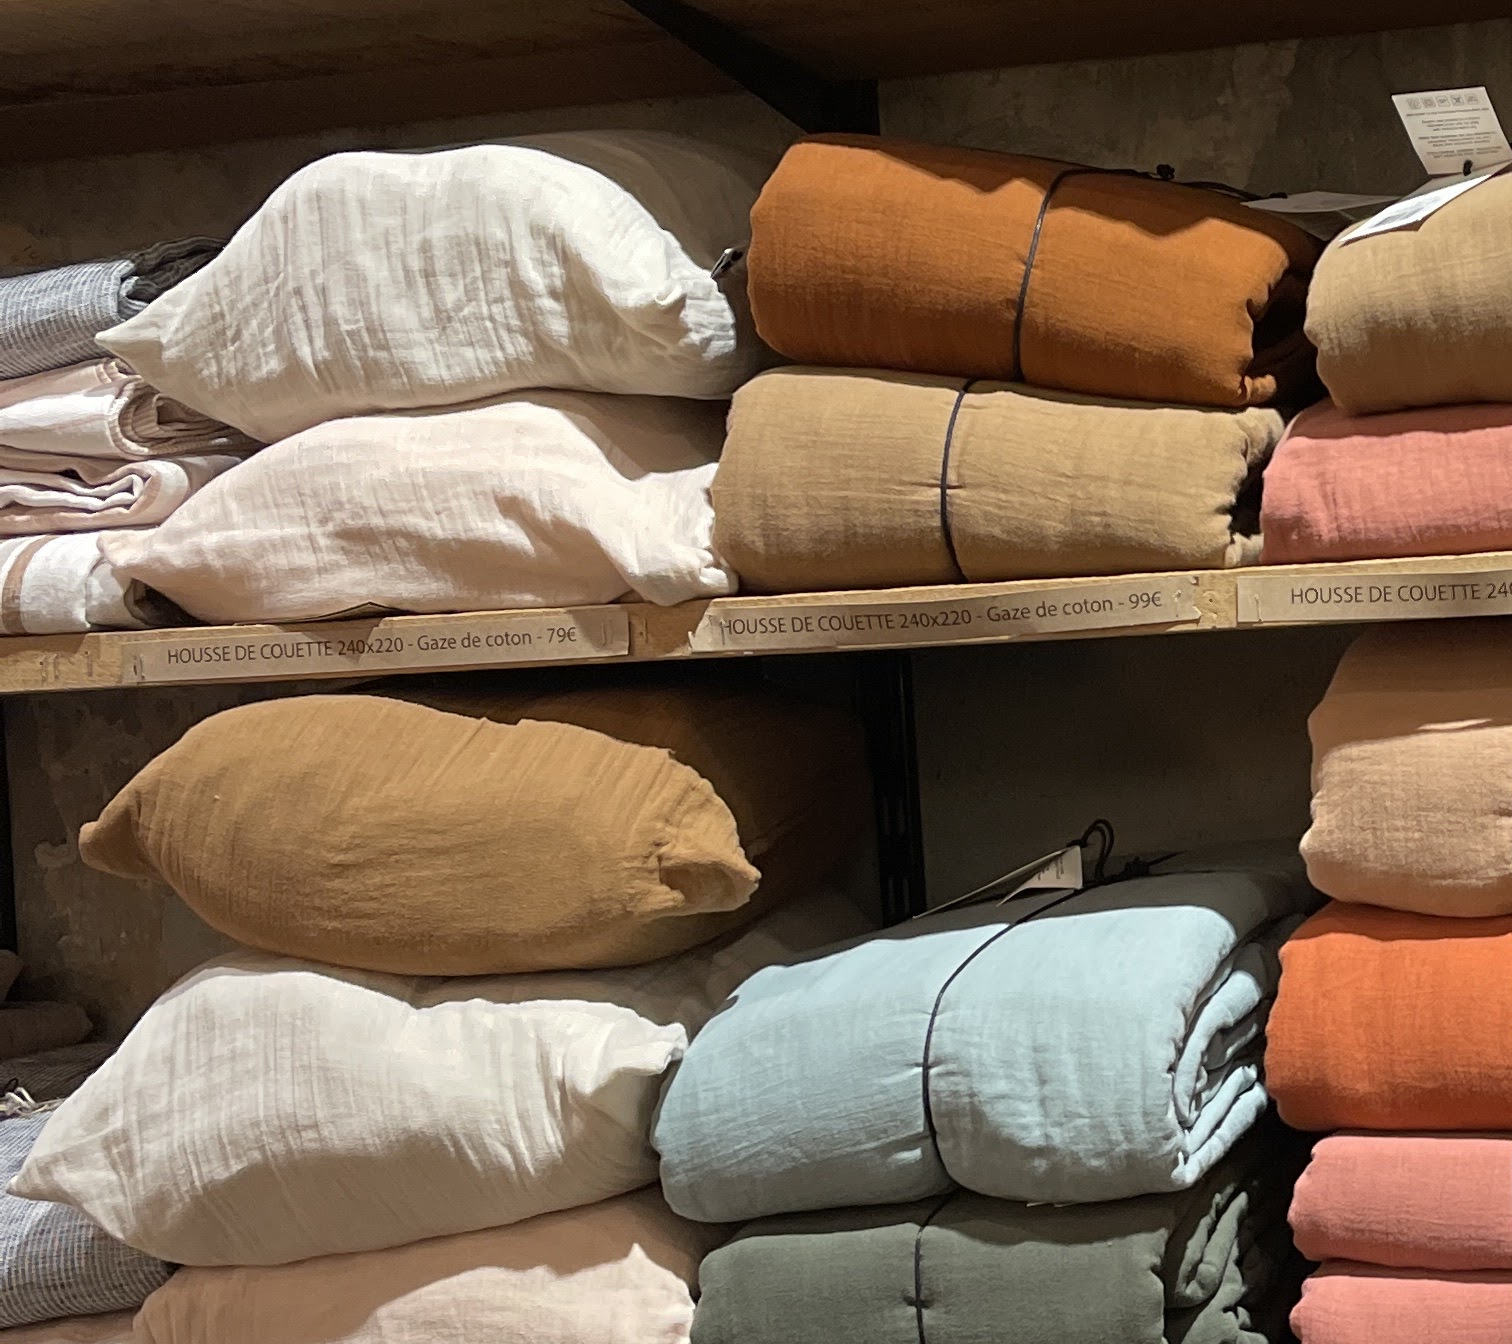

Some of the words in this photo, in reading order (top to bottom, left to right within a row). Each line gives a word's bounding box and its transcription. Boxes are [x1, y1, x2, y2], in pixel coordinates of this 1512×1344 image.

[720, 617, 787, 635] HOUSSE
[791, 615, 814, 633] DE
[818, 613, 893, 632] COUETTE
[899, 609, 972, 629] 240x220
[987, 605, 1031, 622] Gaze
[1036, 600, 1057, 618] de
[1062, 598, 1113, 616] coton
[1128, 590, 1163, 610] 99€
[1291, 586, 1364, 605] HOUSSE
[1369, 585, 1393, 603] DE
[1398, 583, 1479, 603] COUETTE
[168, 645, 231, 664] HOUSSE
[234, 644, 257, 661] DE
[260, 640, 333, 660] COUETTE
[338, 637, 403, 656] 240x220
[417, 634, 457, 651] Gaze
[461, 631, 481, 649] de
[485, 631, 532, 648] coton
[547, 626, 577, 644] 79€
